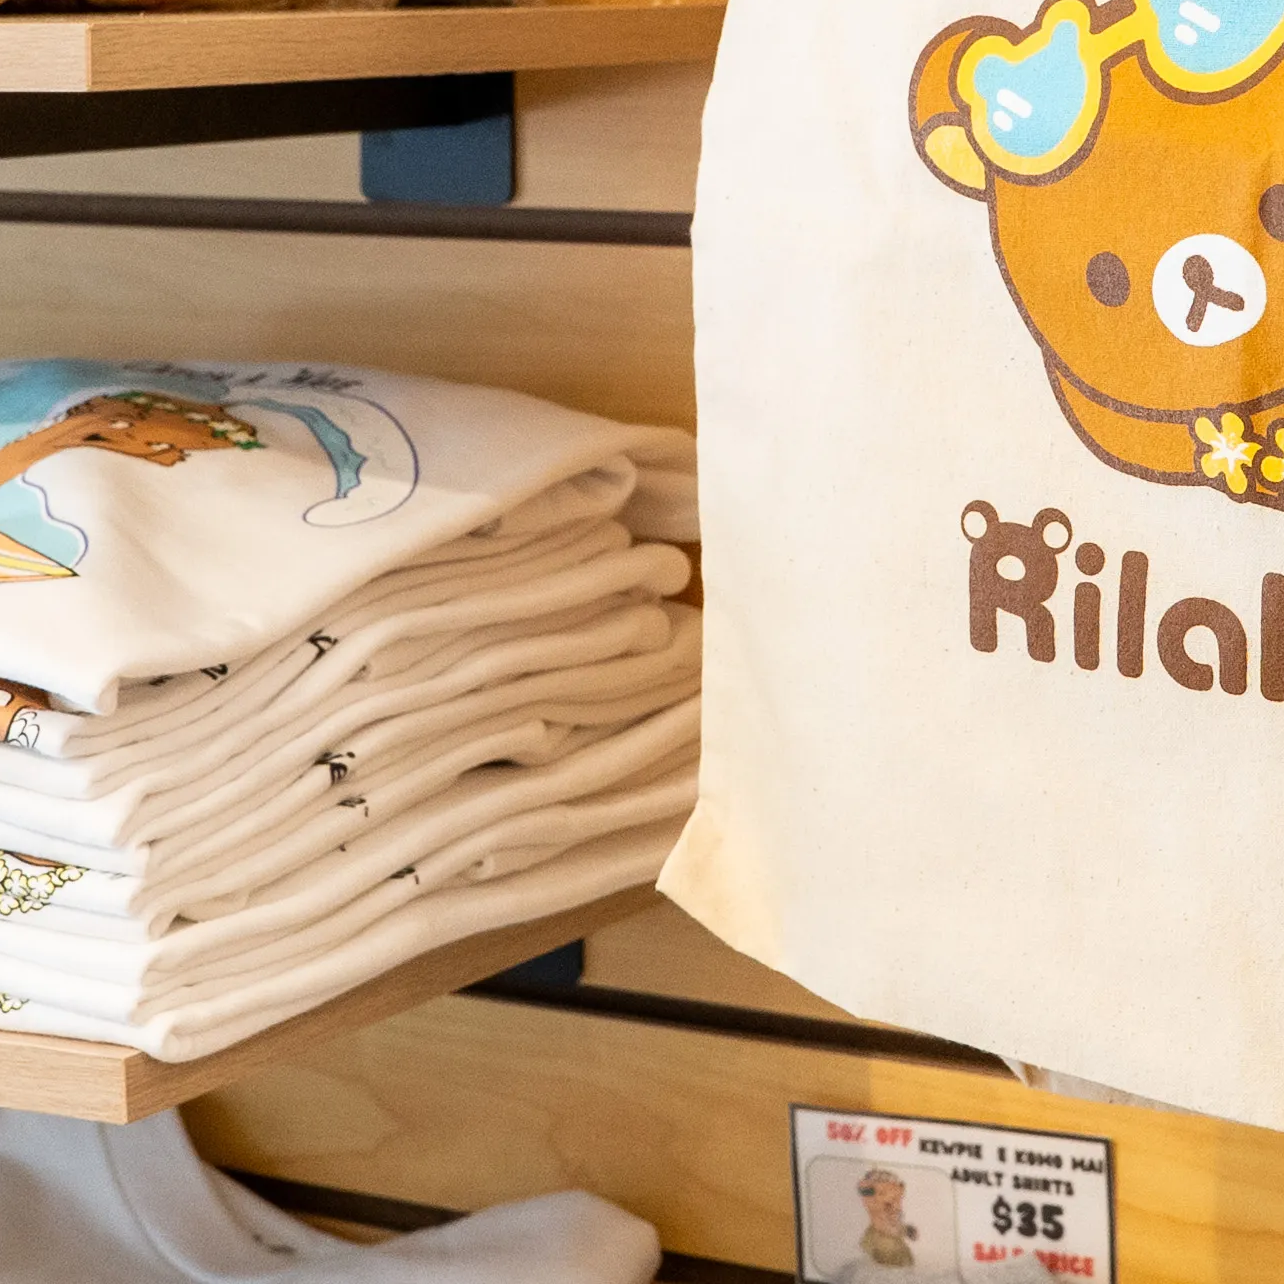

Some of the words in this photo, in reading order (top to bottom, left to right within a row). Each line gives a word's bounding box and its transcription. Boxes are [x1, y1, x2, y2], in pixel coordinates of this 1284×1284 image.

[875, 1125, 914, 1149] OFF
[918, 1138, 983, 1160] KEWPIE
[1014, 1149, 1064, 1169] KOMO
[1070, 1156, 1104, 1175] MAI
[950, 1166, 1004, 1188] ADULT
[1012, 1174, 1076, 1197] SHIRTS
[991, 1194, 1065, 1242] $35
